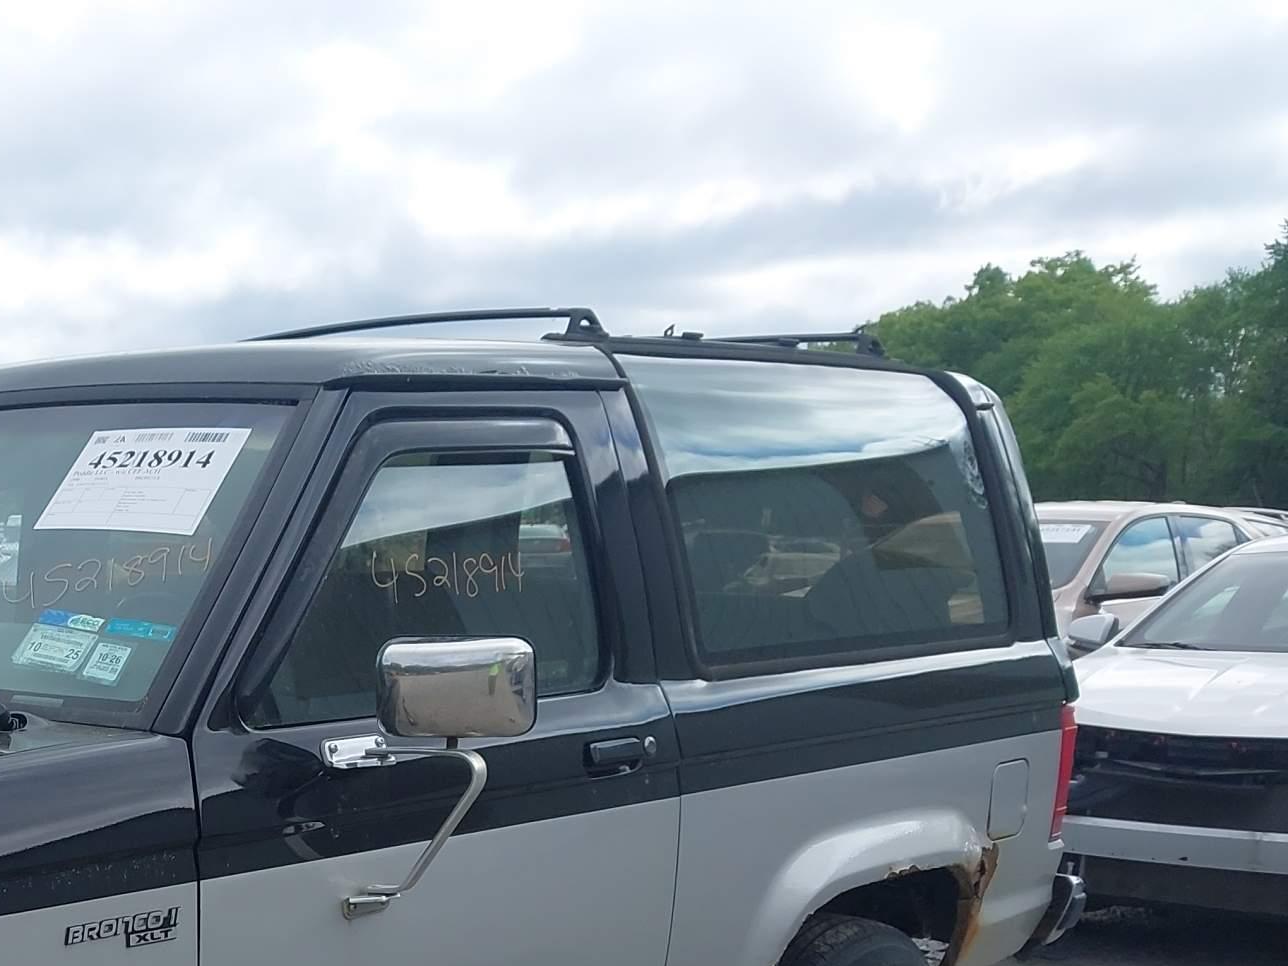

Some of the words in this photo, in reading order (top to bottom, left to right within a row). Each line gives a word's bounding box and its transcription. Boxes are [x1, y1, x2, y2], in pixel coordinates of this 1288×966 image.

[88, 448, 216, 469] 45218914
[1, 537, 213, 609] 45218914
[371, 551, 525, 605] 45218914
[28, 641, 42, 652] 10
[65, 648, 82, 660] 25
[64, 910, 164, 945] BRONCO
[136, 927, 173, 943] XLT
